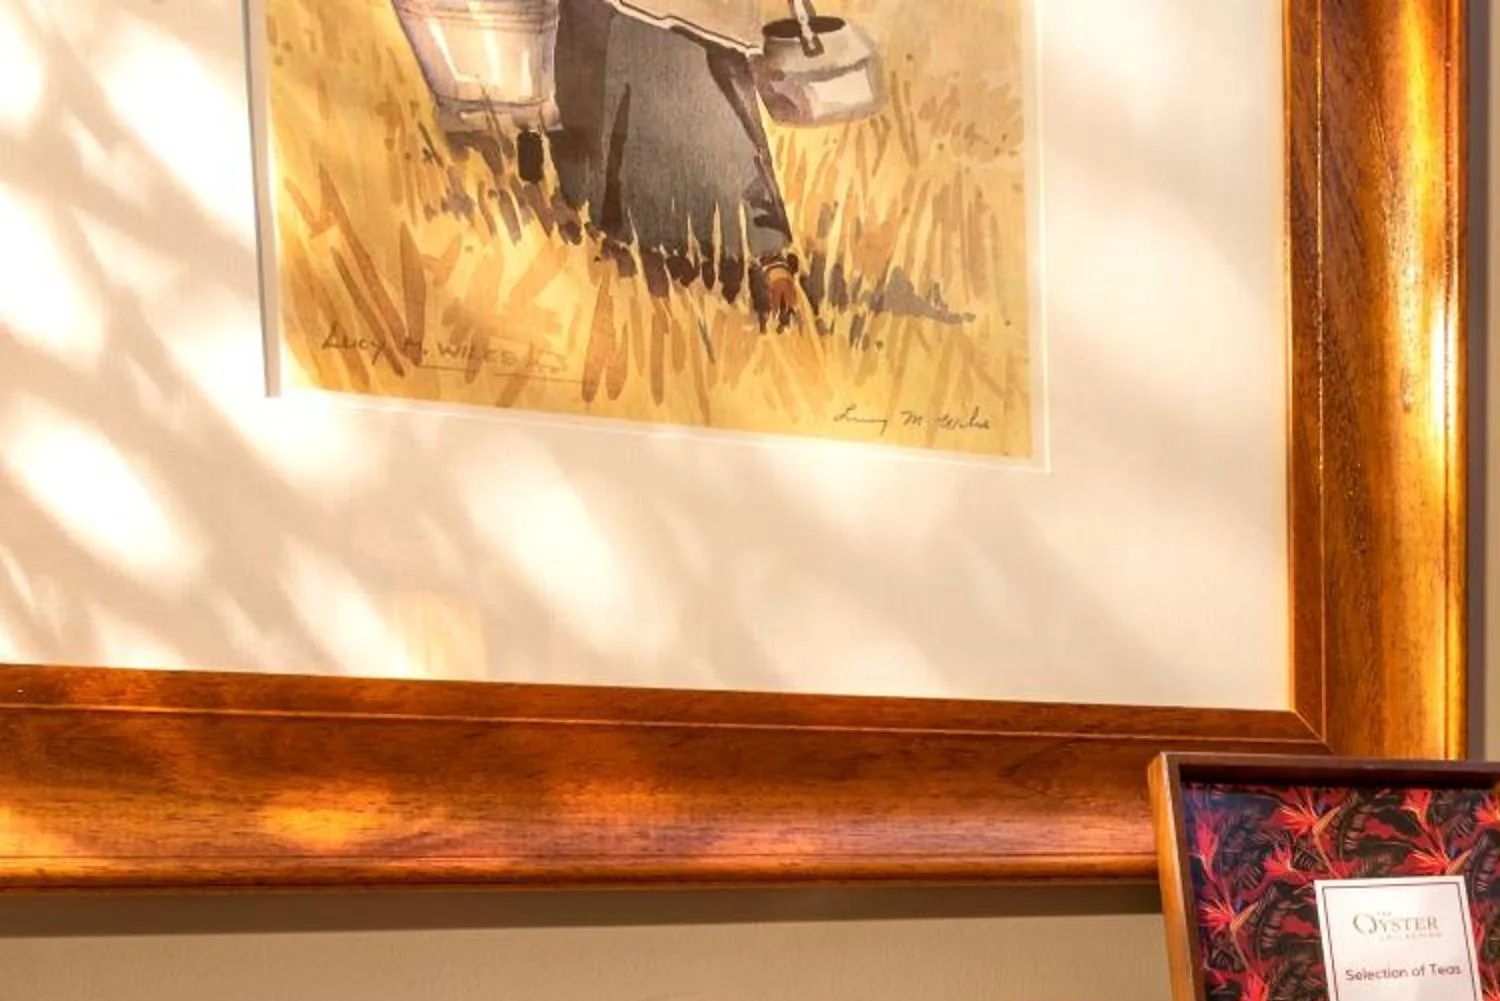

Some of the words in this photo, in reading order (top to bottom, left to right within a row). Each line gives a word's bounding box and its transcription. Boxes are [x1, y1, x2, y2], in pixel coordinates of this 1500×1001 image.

[1345, 966, 1408, 981] Selection
[1411, 963, 1426, 977] of
[1428, 962, 1462, 976] Teas
